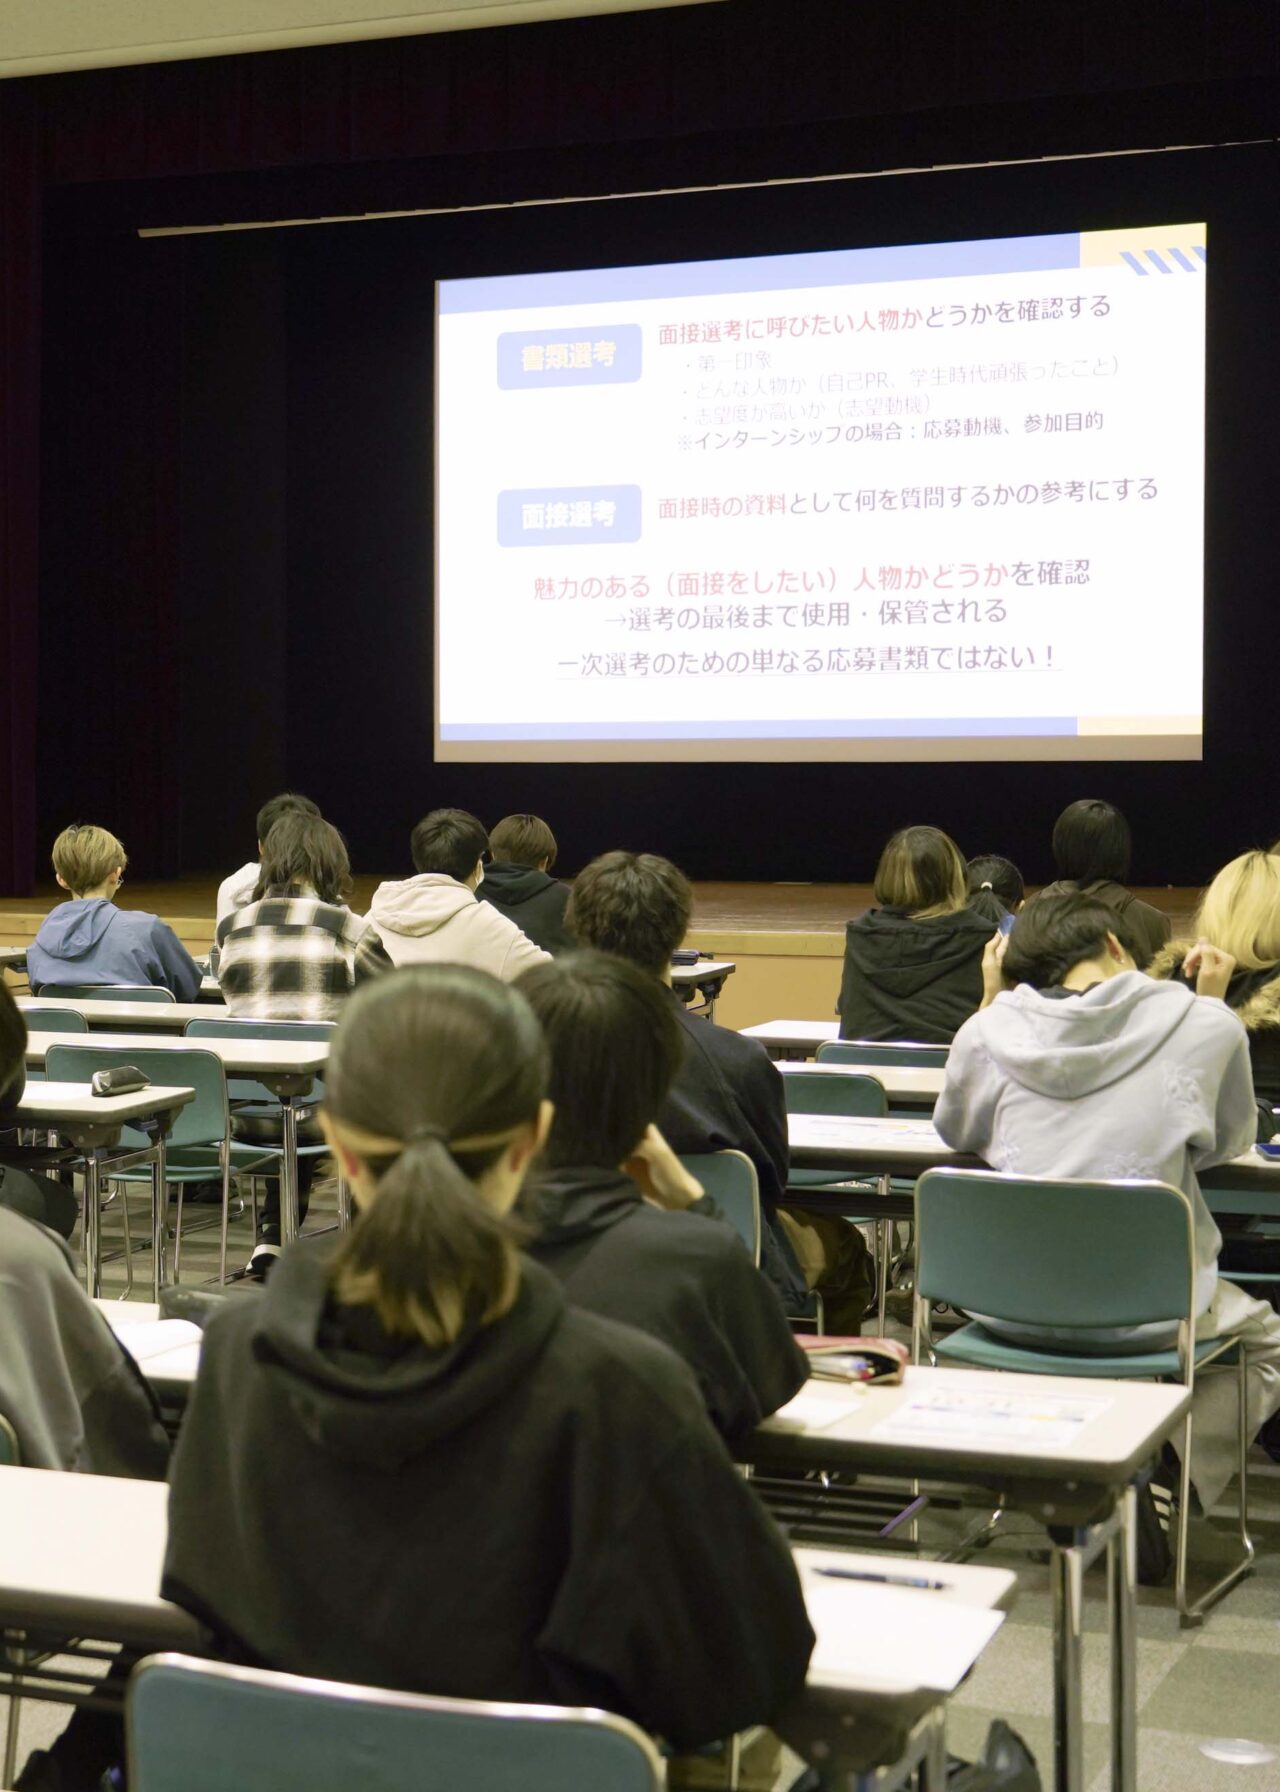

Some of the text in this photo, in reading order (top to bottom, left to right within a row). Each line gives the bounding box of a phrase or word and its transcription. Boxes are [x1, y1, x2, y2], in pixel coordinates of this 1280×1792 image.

[658, 293, 1111, 346] 面接選考に呼びたい人物かどうかを確認する
[521, 340, 617, 372] 書類選考
[521, 499, 617, 530] 面接選考
[658, 477, 1159, 520] 面接時の資料として何を質問するかの参考にする
[534, 558, 1091, 601] 魅力のある（面接をしたい）人物かどうかを確認
[557, 644, 1054, 677] 一次選考のための単なる応募書類ではない！
